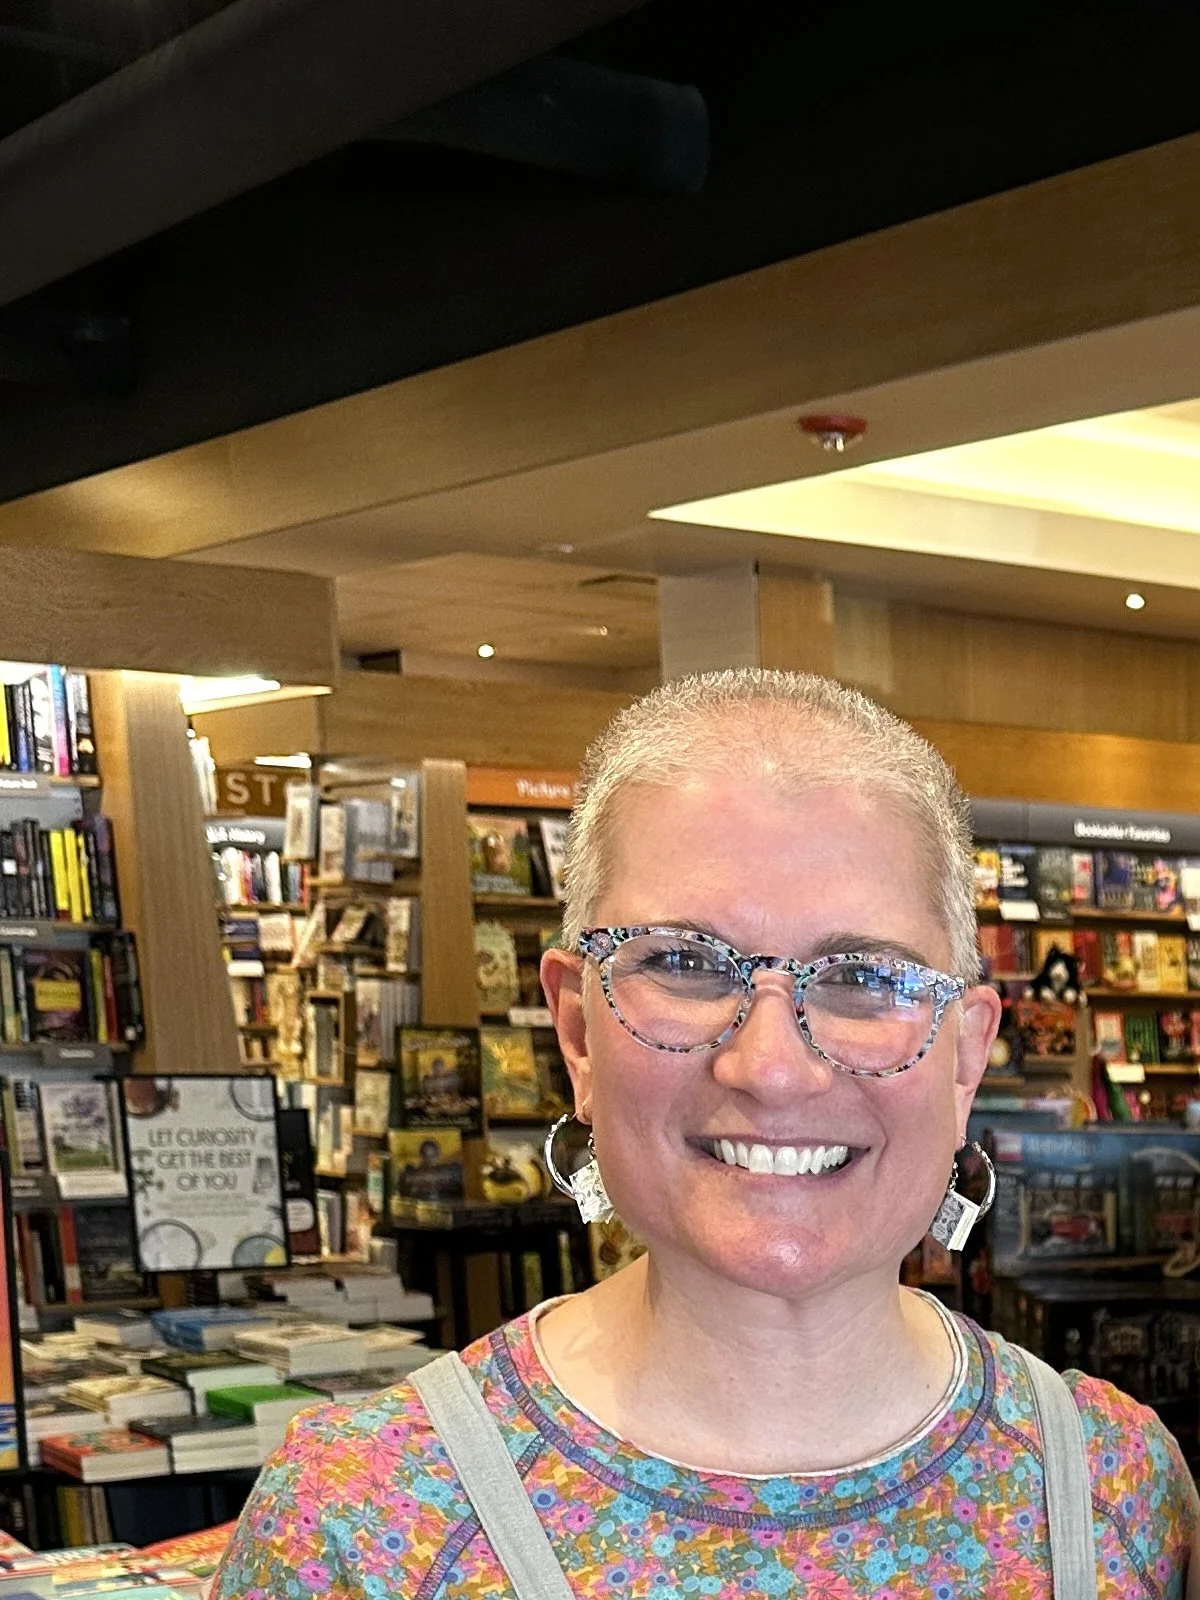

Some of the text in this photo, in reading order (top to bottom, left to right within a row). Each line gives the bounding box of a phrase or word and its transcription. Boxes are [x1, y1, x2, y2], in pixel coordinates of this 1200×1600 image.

[149, 1126, 256, 1147] LET CURIOSITY
[157, 1150, 251, 1169] GET THE BEST
[176, 1171, 238, 1191] OF YOU
